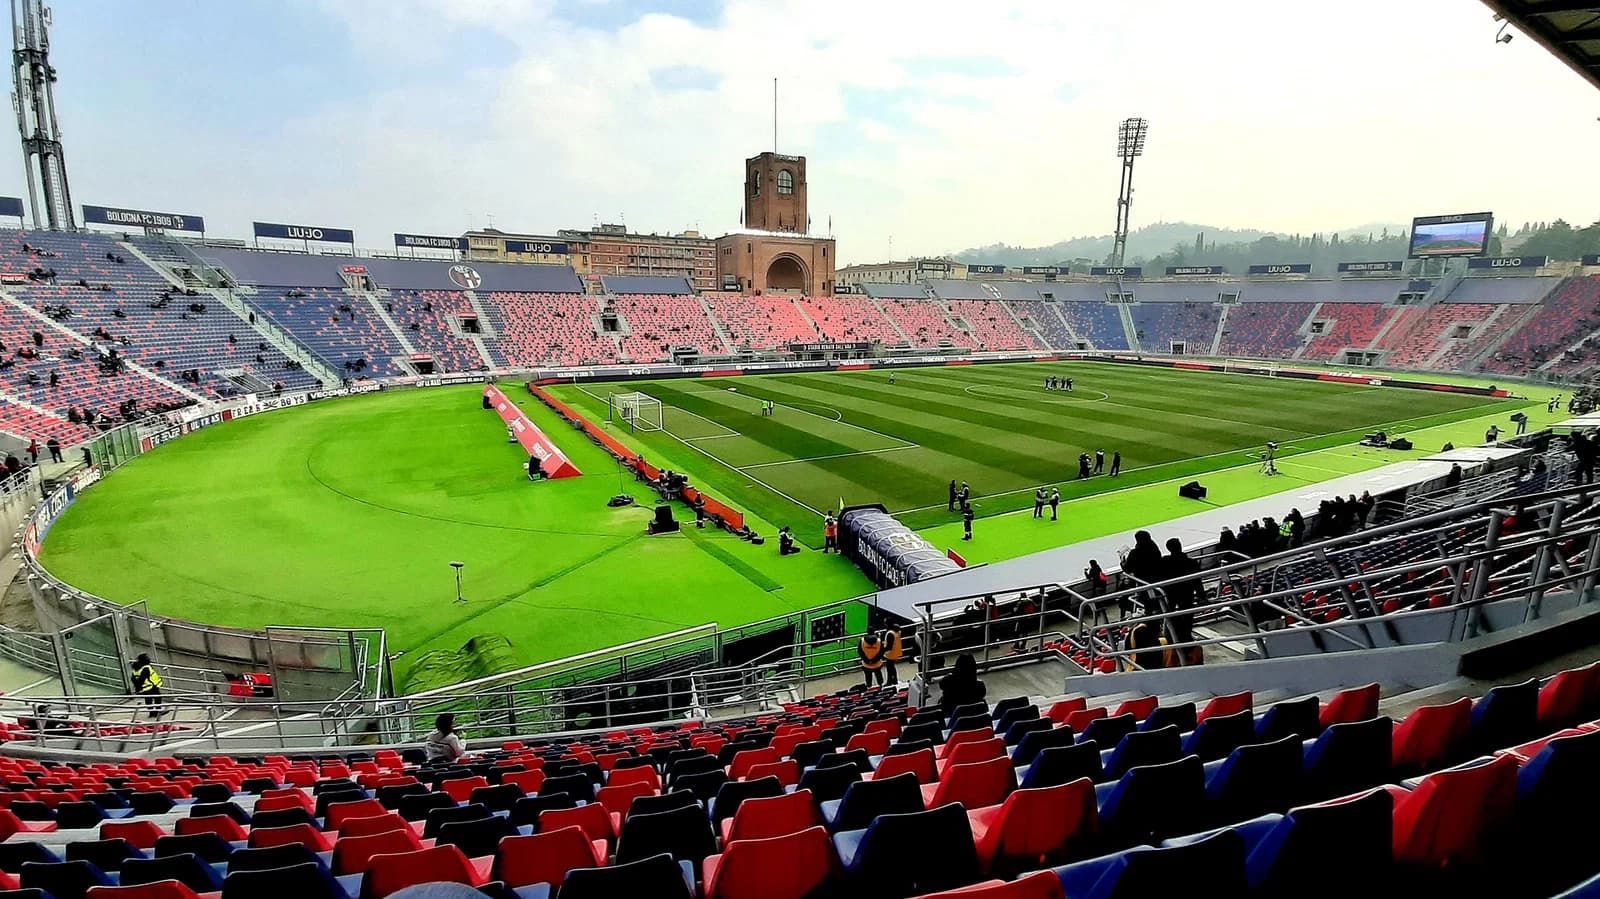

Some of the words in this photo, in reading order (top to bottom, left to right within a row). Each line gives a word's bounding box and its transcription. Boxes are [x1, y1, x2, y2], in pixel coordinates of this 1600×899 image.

[106, 210, 141, 224] BOLOGNA
[142, 214, 152, 225] FC
[153, 215, 172, 226] 1909
[310, 389, 348, 399] VECCHIO
[350, 384, 380, 394] CUORE
